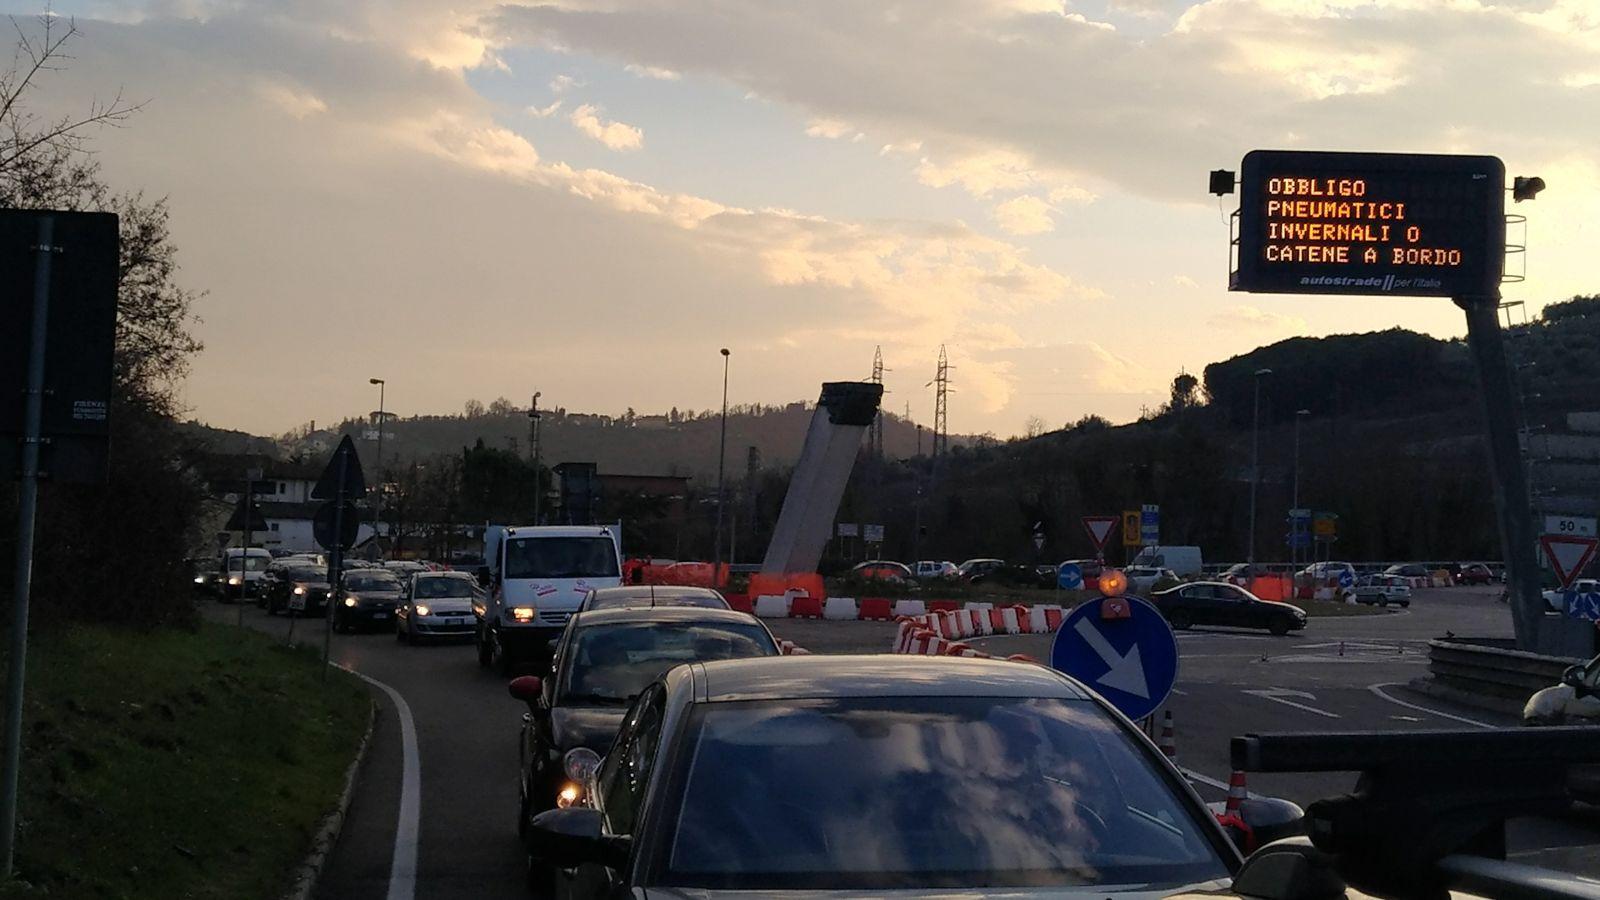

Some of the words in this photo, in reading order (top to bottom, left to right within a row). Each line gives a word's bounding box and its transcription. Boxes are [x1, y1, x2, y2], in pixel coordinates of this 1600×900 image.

[1268, 177, 1366, 197] OBBLIGO
[1267, 200, 1405, 220] PNEUMATICI
[1269, 222, 1390, 242] INVERNALI
[1406, 226, 1420, 243] O
[1266, 244, 1350, 263] CATENE
[1364, 247, 1377, 264] A
[1392, 247, 1461, 266] BORDO
[1300, 275, 1382, 287] autostrade
[1559, 520, 1575, 531] 50
